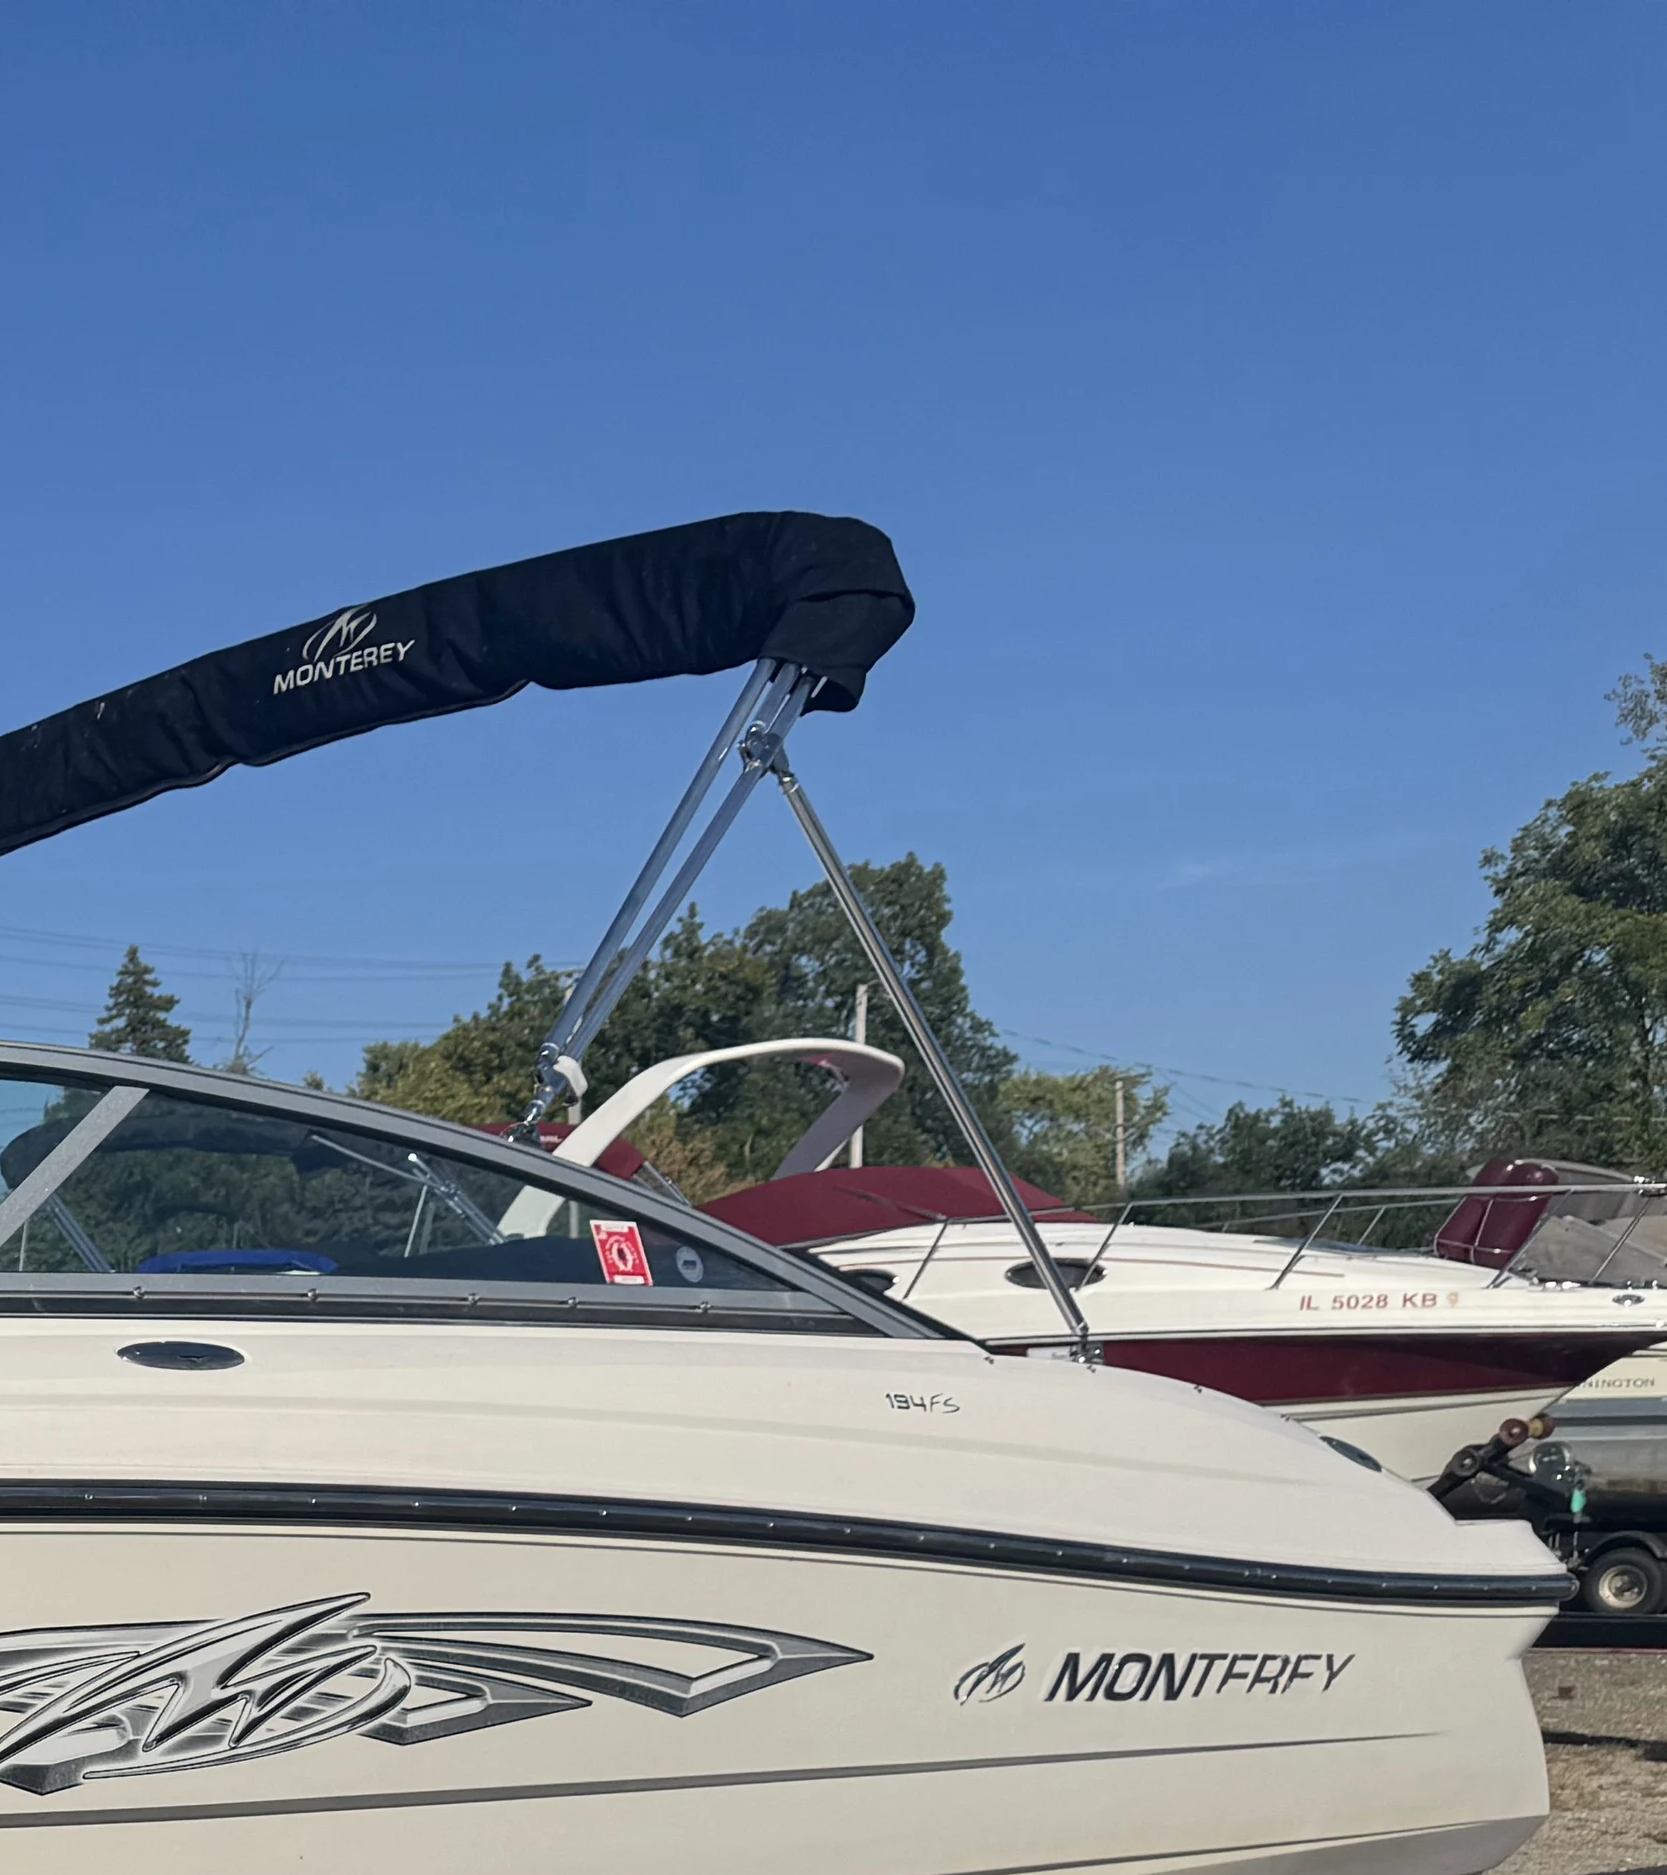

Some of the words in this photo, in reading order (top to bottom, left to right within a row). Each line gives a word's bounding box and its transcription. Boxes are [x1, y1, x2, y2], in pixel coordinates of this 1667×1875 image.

[273, 639, 415, 695] MONTEREY
[1299, 1294, 1319, 1311] IL
[1331, 1293, 1388, 1310] 5028
[1402, 1292, 1438, 1308] KB
